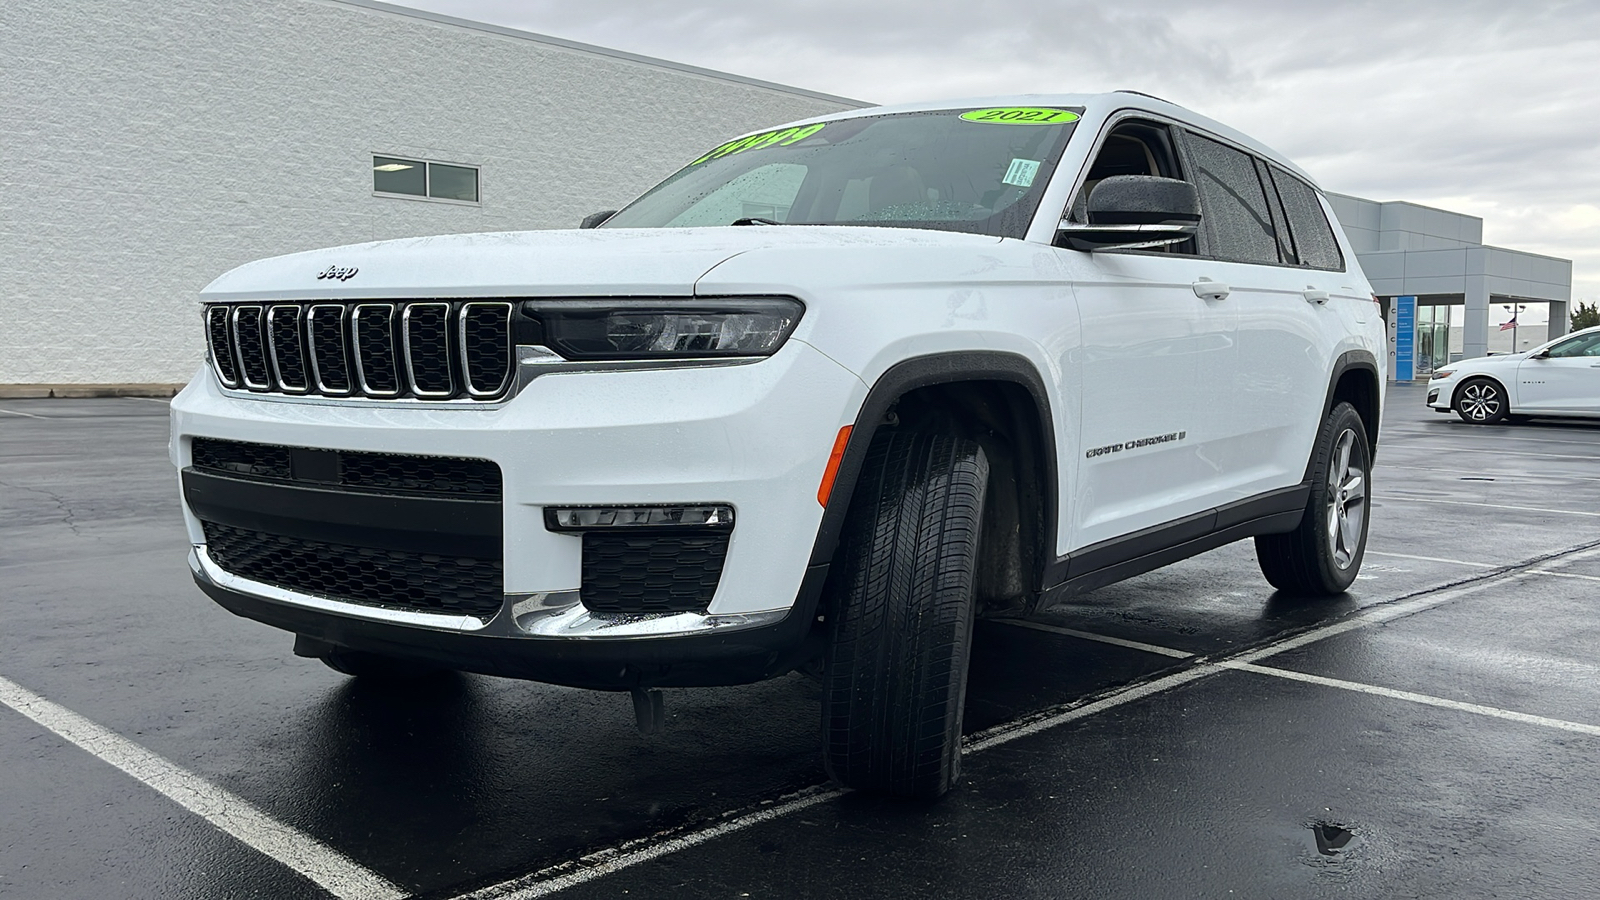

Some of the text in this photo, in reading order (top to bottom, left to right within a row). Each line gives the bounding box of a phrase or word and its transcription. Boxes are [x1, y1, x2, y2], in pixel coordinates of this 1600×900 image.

[976, 110, 1063, 122] 2021
[317, 264, 359, 282] Jeep
[1086, 443, 1123, 458] GRAND
[1125, 432, 1177, 450] CHEROKEE
